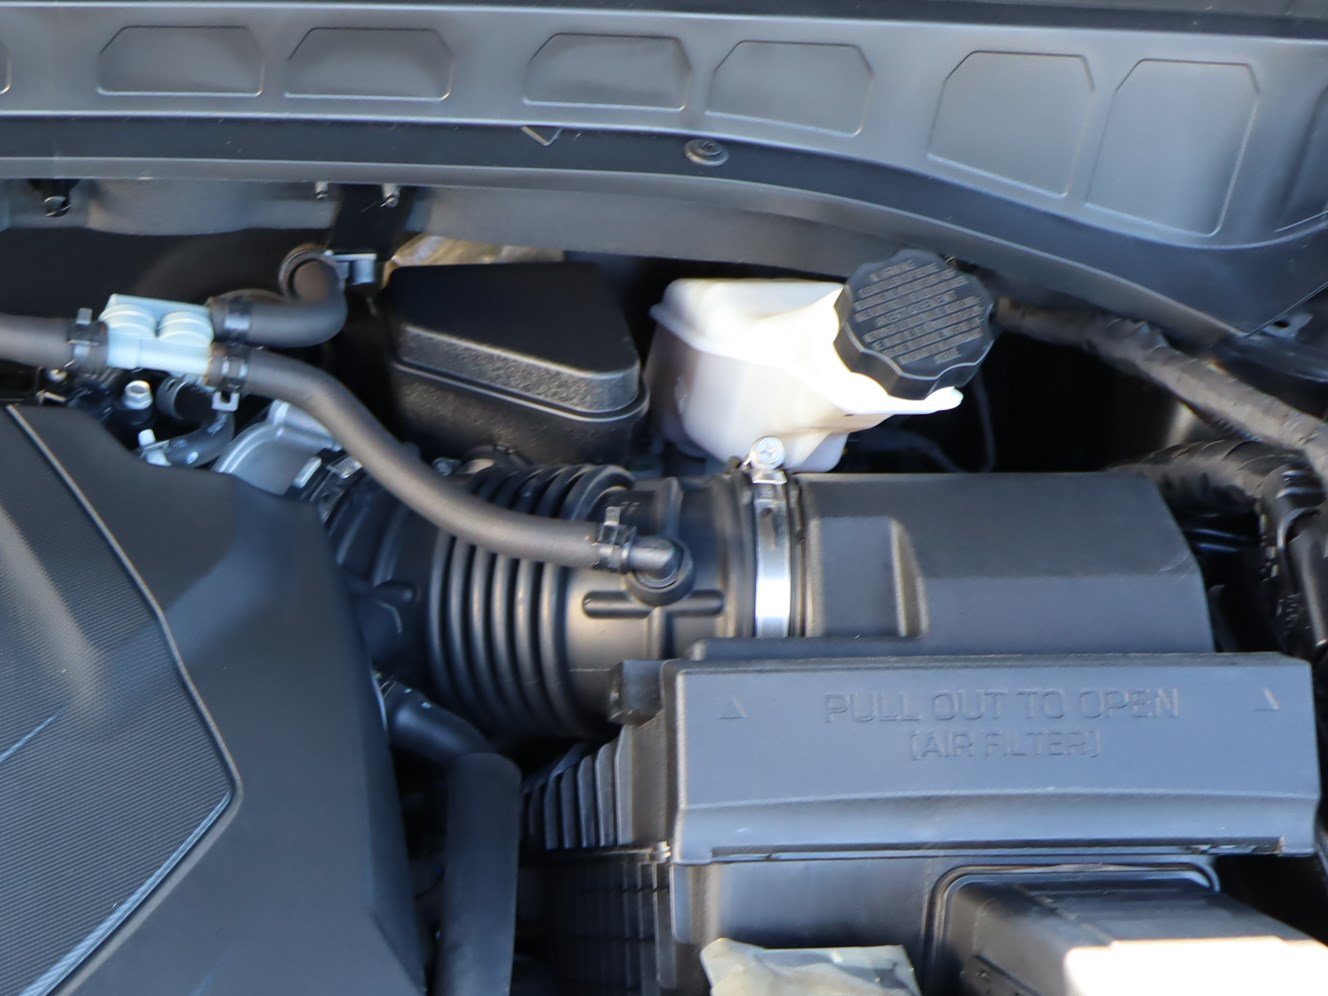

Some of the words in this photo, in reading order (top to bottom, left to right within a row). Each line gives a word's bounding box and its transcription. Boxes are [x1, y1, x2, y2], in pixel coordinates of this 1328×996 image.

[825, 690, 922, 723] PULL
[933, 688, 1009, 721] OUT
[1016, 688, 1066, 719] TO
[1079, 687, 1181, 719] OPEN
